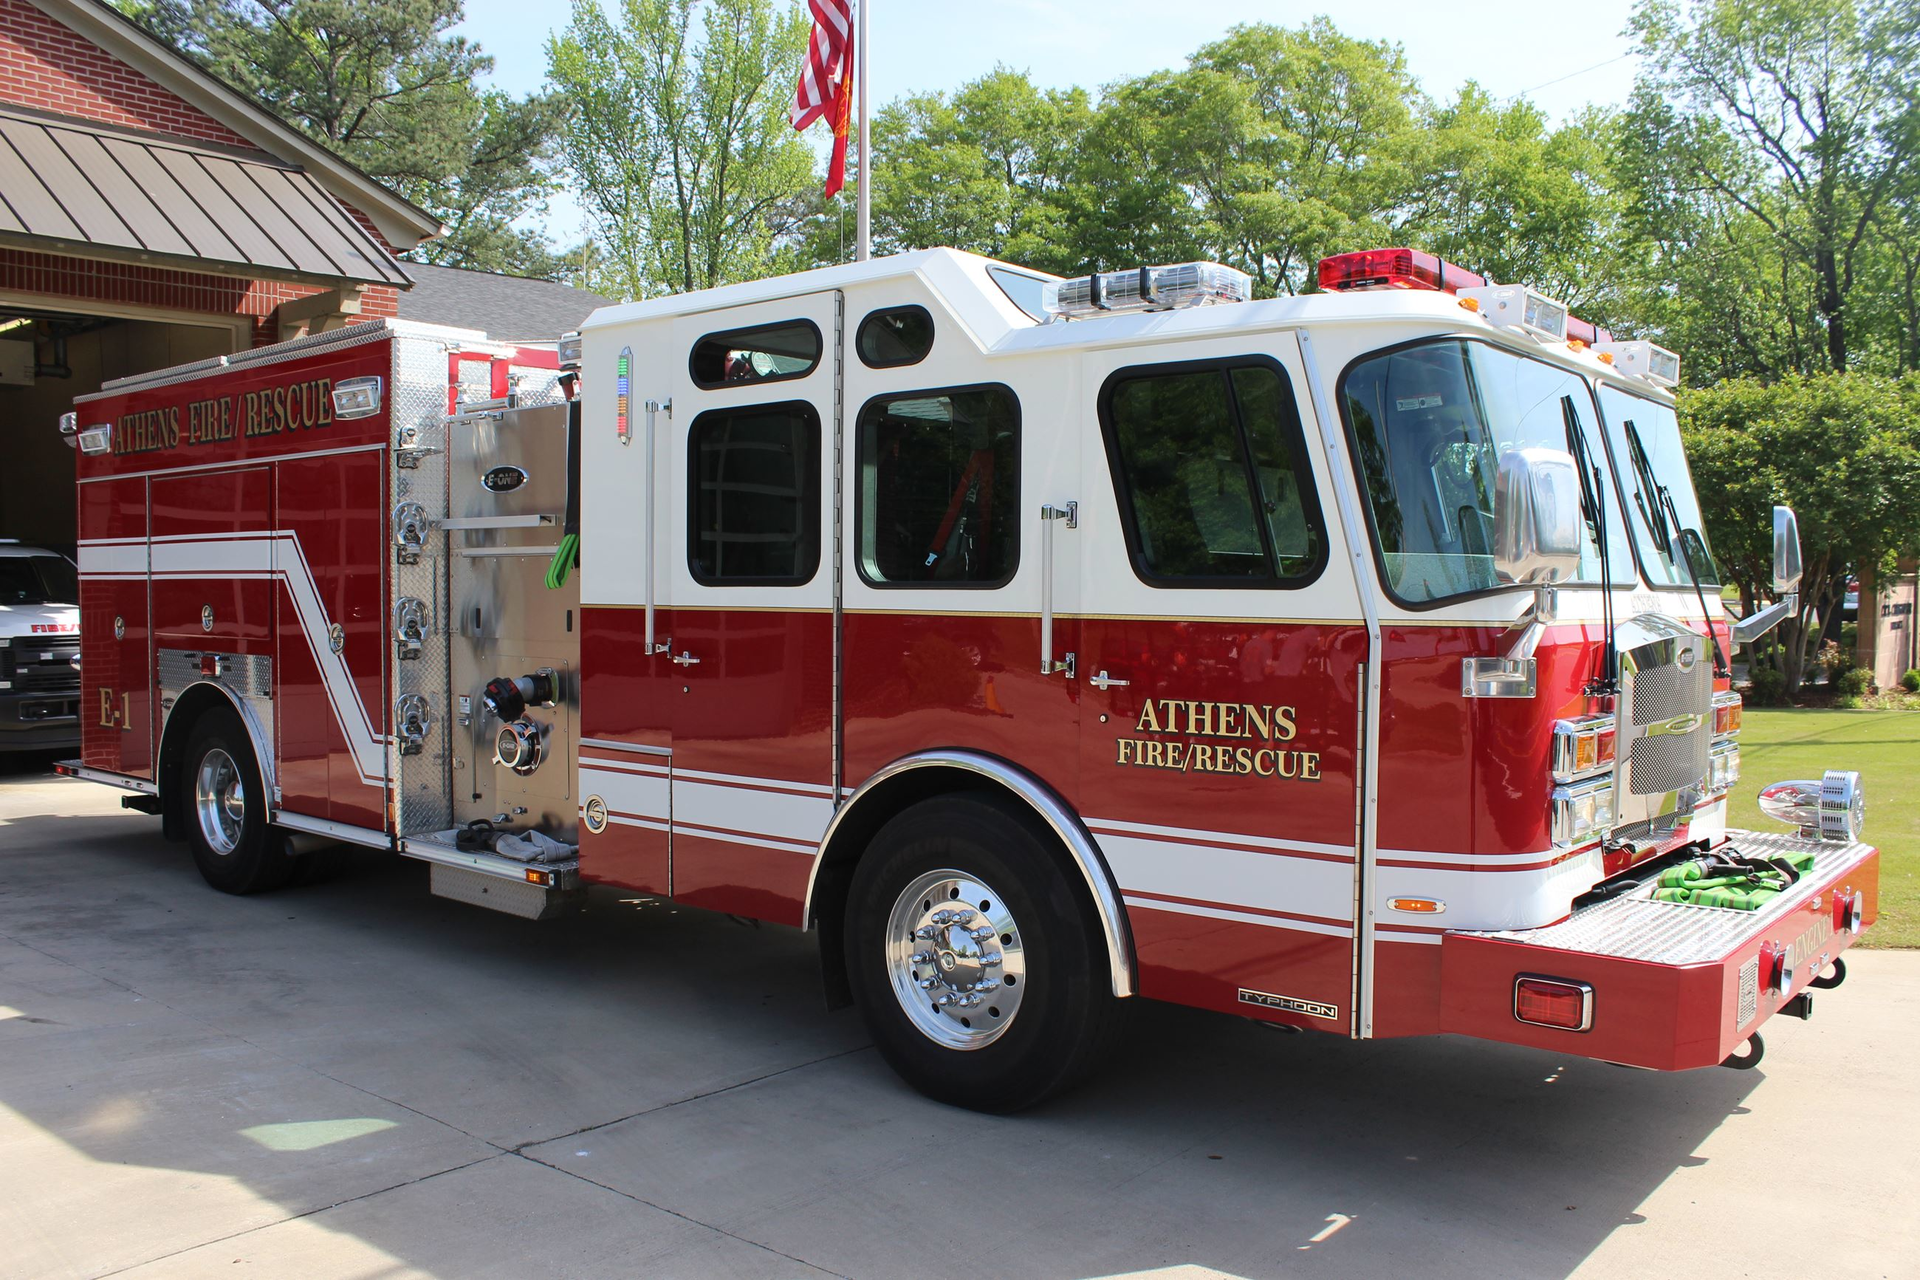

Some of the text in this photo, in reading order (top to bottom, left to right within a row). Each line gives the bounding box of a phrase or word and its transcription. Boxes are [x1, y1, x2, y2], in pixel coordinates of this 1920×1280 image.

[114, 405, 180, 455] ATHENS
[99, 687, 131, 730] E-1
[1135, 698, 1297, 742] ATHENS
[1116, 738, 1321, 781] FIRE/RESCUE
[1795, 914, 1828, 967] ENGINE
[1240, 991, 1335, 1017] TYPHOON
